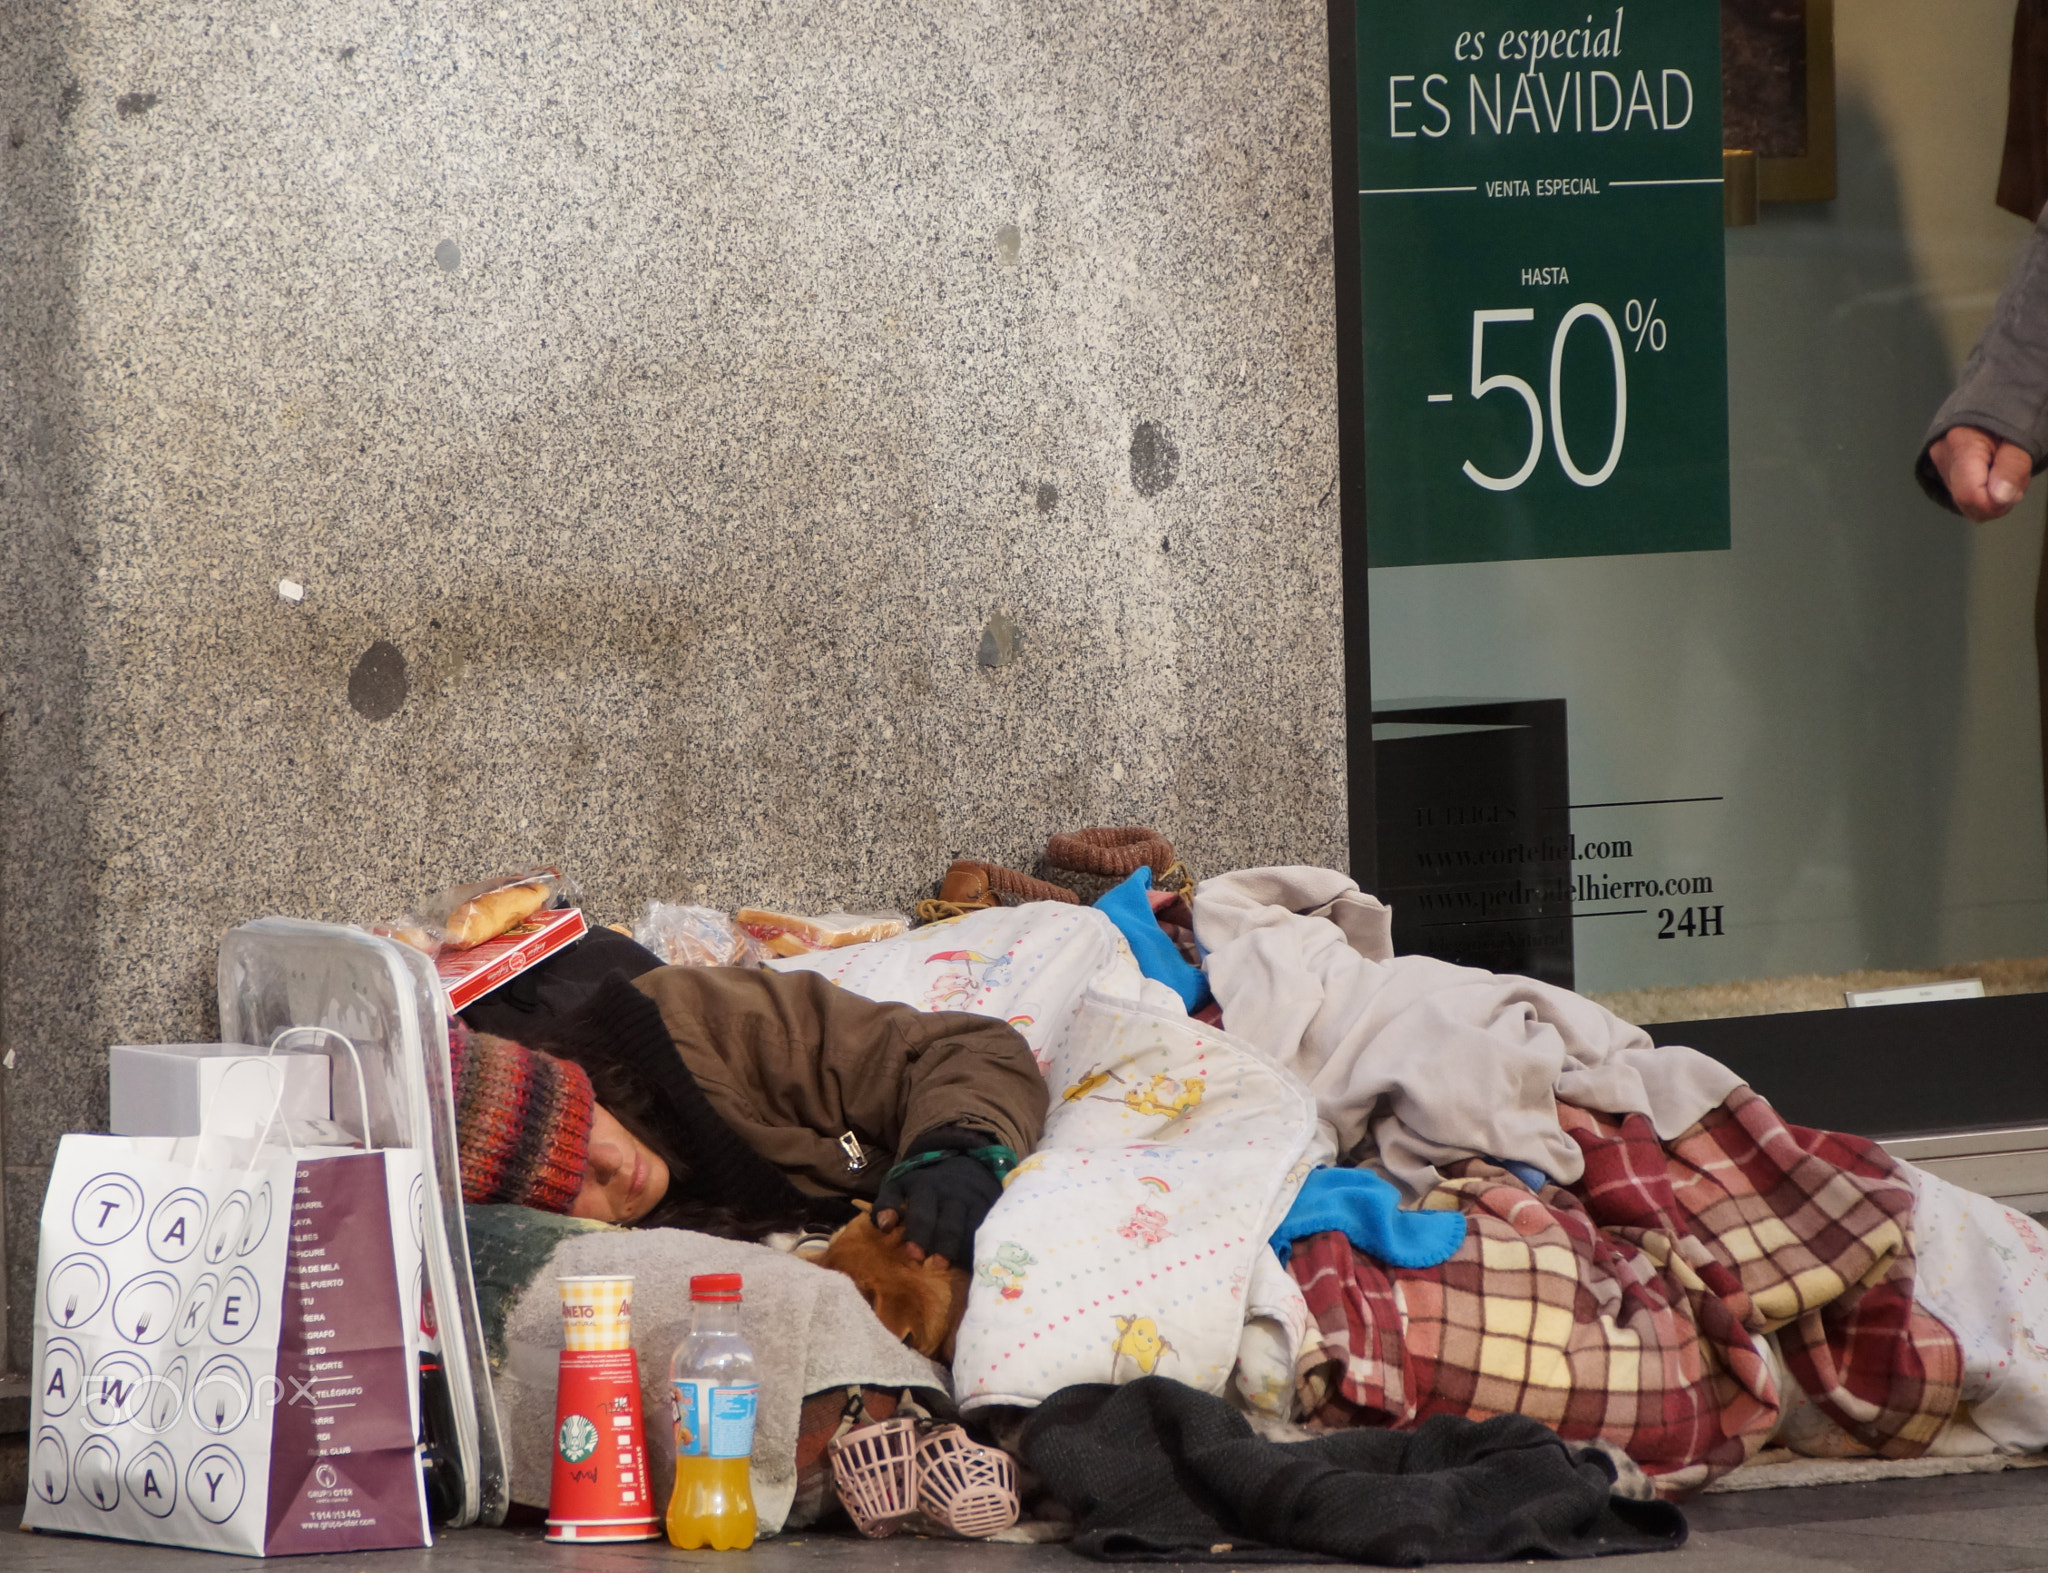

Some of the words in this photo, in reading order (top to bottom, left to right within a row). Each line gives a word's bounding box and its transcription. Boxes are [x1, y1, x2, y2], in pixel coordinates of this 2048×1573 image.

[1455, 30, 1486, 61] es
[1498, 6, 1624, 76] especial
[1389, 73, 1451, 138] ES
[1469, 68, 1694, 135] NAVIDAD
[1485, 180, 1531, 198] VENTA
[1536, 177, 1601, 196] ESPECIAL
[1521, 267, 1570, 286] HASTA
[1416, 834, 1633, 868] www.cortefiel.com
[1417, 873, 1714, 916] www.pedrodelhierro.com
[1657, 904, 1726, 940] 24H
[97, 1200, 119, 1229] T
[162, 1216, 186, 1246] A
[222, 1296, 241, 1326] E
[46, 1367, 66, 1398] A
[143, 1469, 162, 1498] A
[205, 1472, 224, 1503] Y
